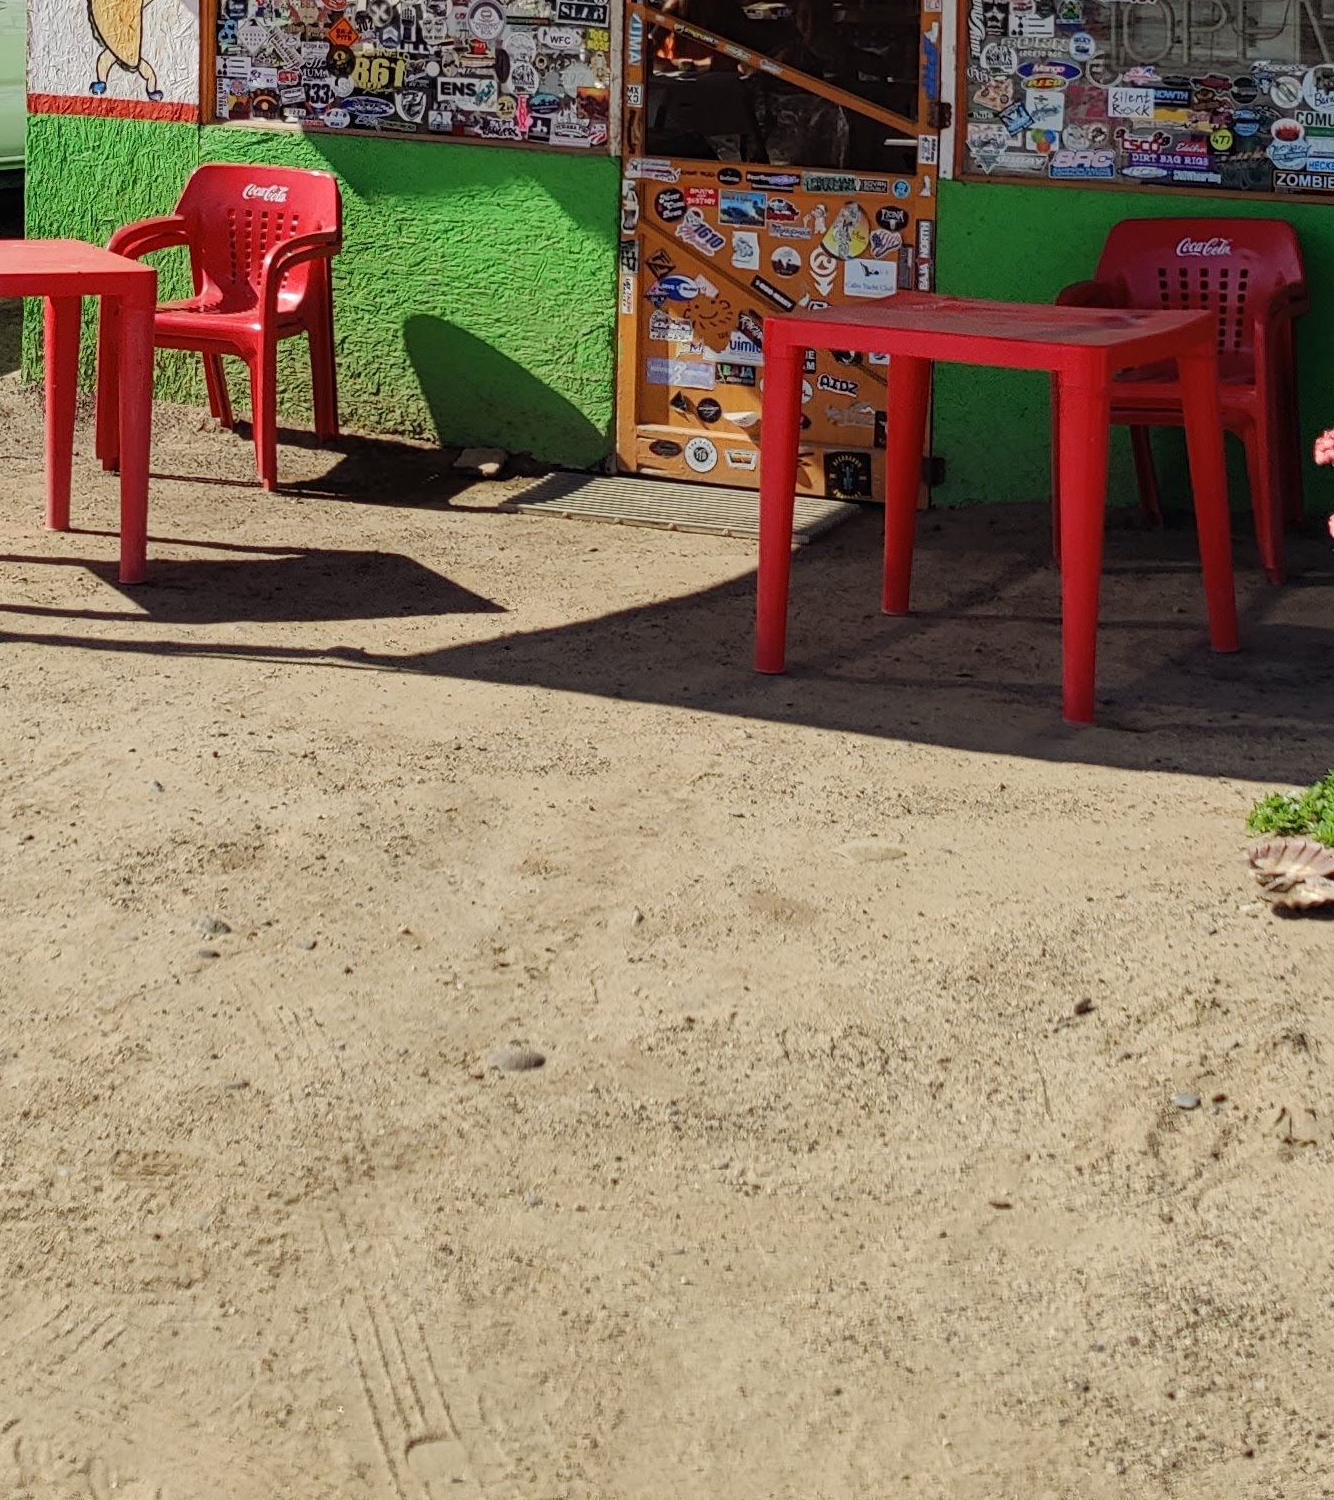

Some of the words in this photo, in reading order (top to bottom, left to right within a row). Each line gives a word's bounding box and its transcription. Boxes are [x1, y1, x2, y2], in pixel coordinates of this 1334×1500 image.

[549, 35, 571, 45] WFC
[1112, 89, 1150, 104] Silent
[1212, 135, 1230, 145] 477
[1132, 153, 1157, 162] DIRT
[1160, 154, 1181, 164] BAG
[1184, 156, 1209, 166] RIGS
